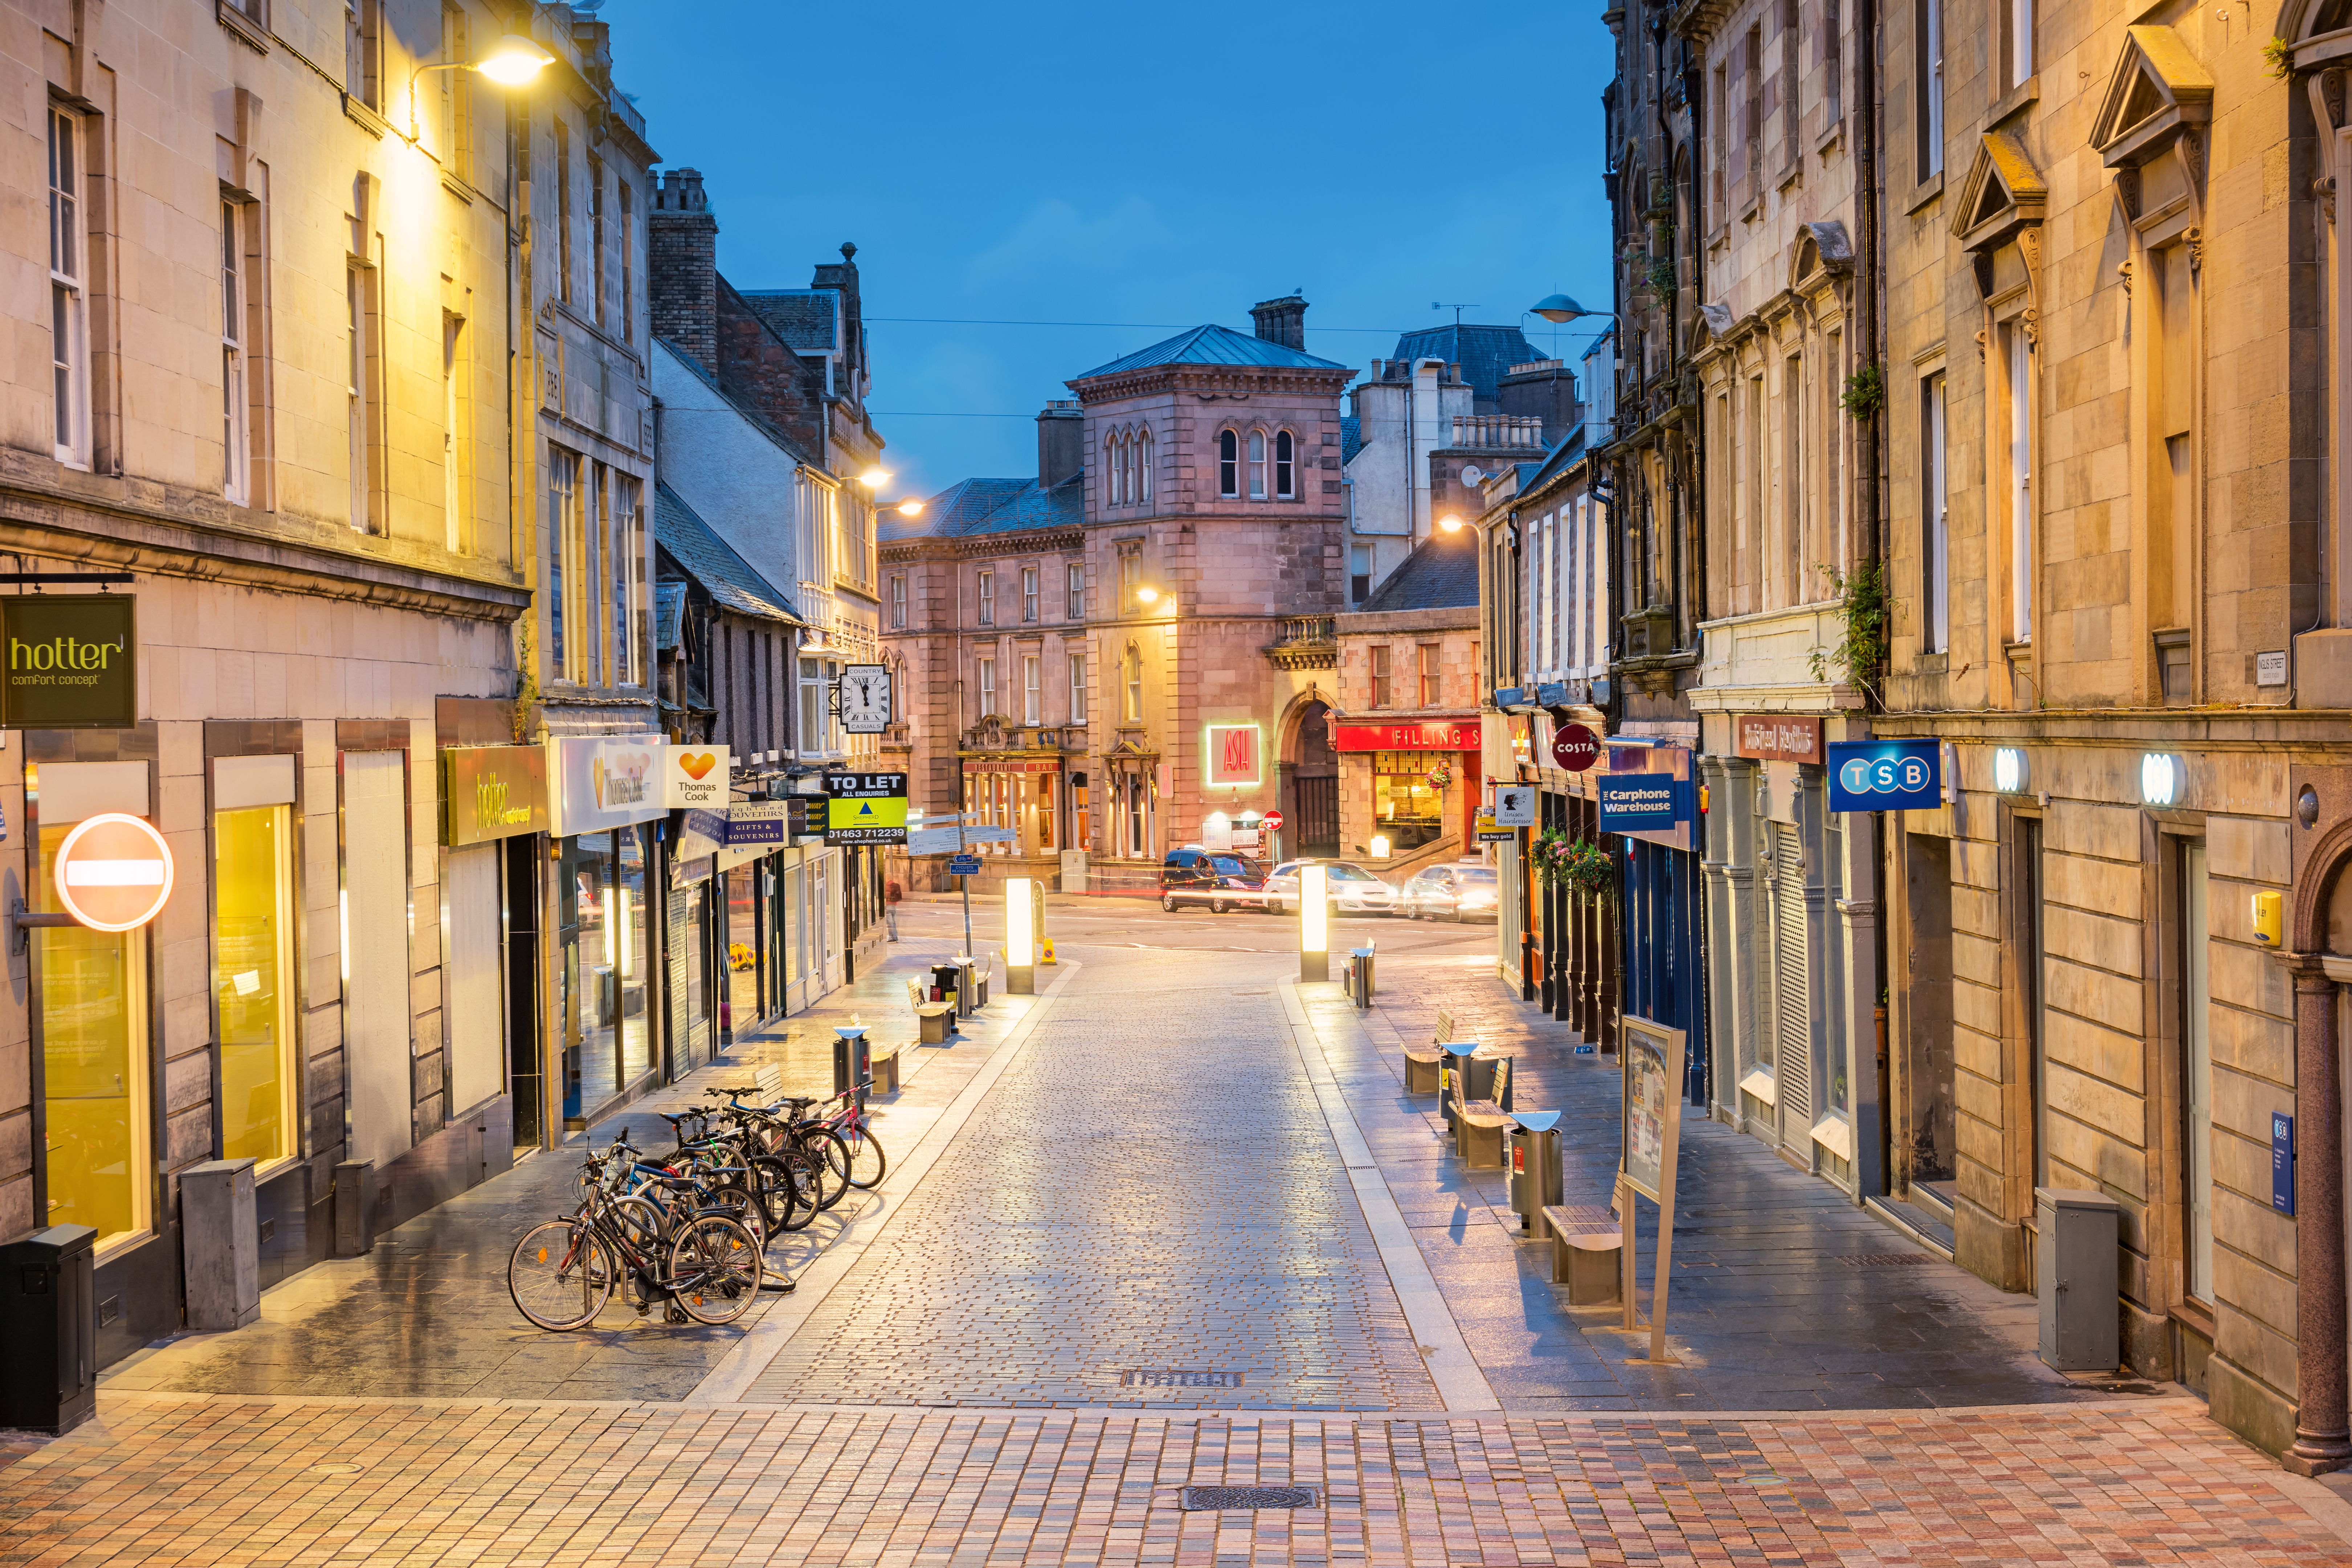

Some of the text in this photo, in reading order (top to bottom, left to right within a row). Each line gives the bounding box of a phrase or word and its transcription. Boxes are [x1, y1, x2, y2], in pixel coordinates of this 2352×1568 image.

[12, 637, 121, 670] hotter
[2259, 658, 2284, 670] INGLIS STREET
[12, 674, 98, 687] comfort concept
[1395, 730, 1461, 745] FILLING
[1224, 730, 1249, 771] ASH
[1557, 743, 1595, 753] COSTA
[1850, 765, 1922, 785] TSB
[678, 782, 716, 791] Thomas
[830, 776, 901, 789] TO LET
[477, 772, 509, 829] hotter
[685, 792, 709, 801] Cook
[1610, 789, 1670, 801] Carphone
[1604, 802, 1670, 812] Warehouse
[828, 828, 904, 838] 01463 712239
[2256, 908, 2267, 917] ANLEY
[2276, 1123, 2286, 1136] TSB
